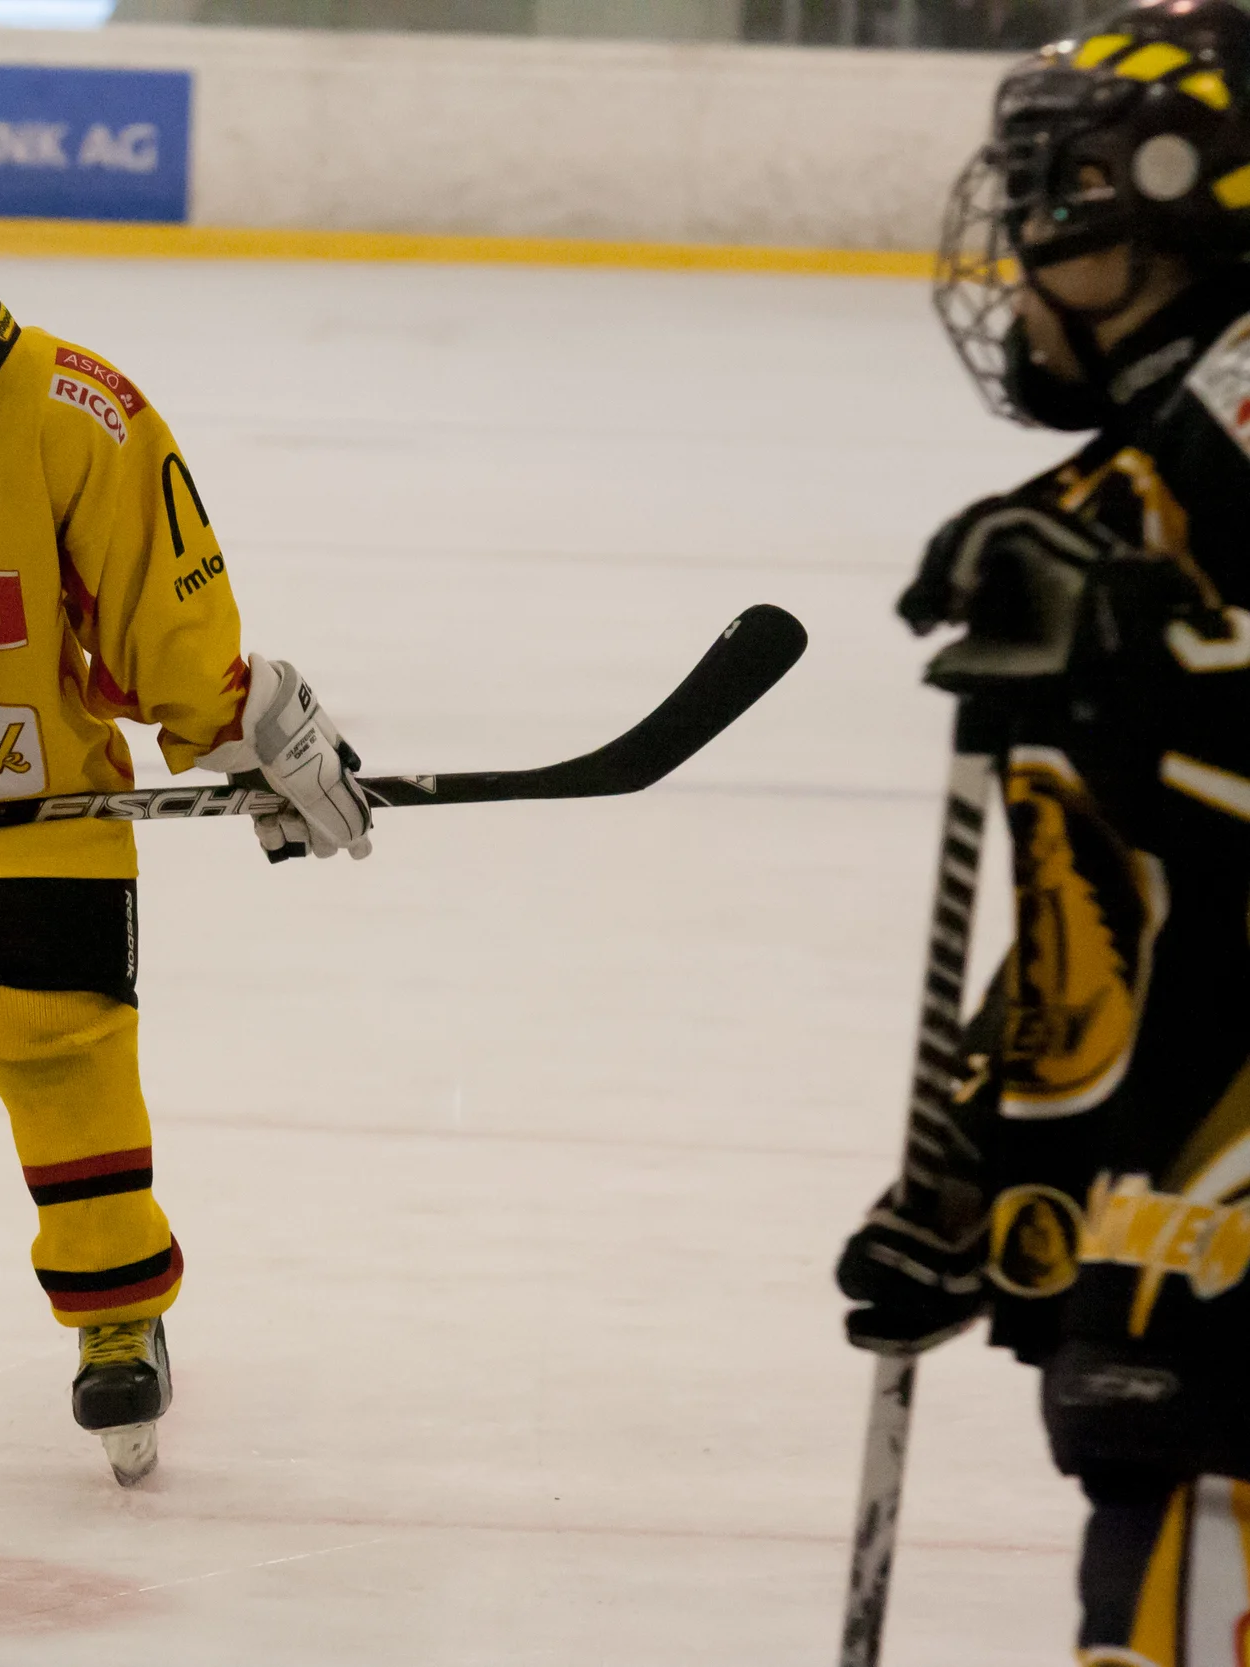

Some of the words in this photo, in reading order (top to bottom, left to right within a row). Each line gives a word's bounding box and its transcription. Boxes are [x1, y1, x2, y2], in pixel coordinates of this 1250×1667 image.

[78, 122, 158, 173] AG
[62, 353, 121, 391] ASKÖ
[173, 566, 208, 603] i'm
[200, 552, 225, 580] lo
[36, 787, 290, 822] FISCHE
[124, 888, 135, 981] Reebok
